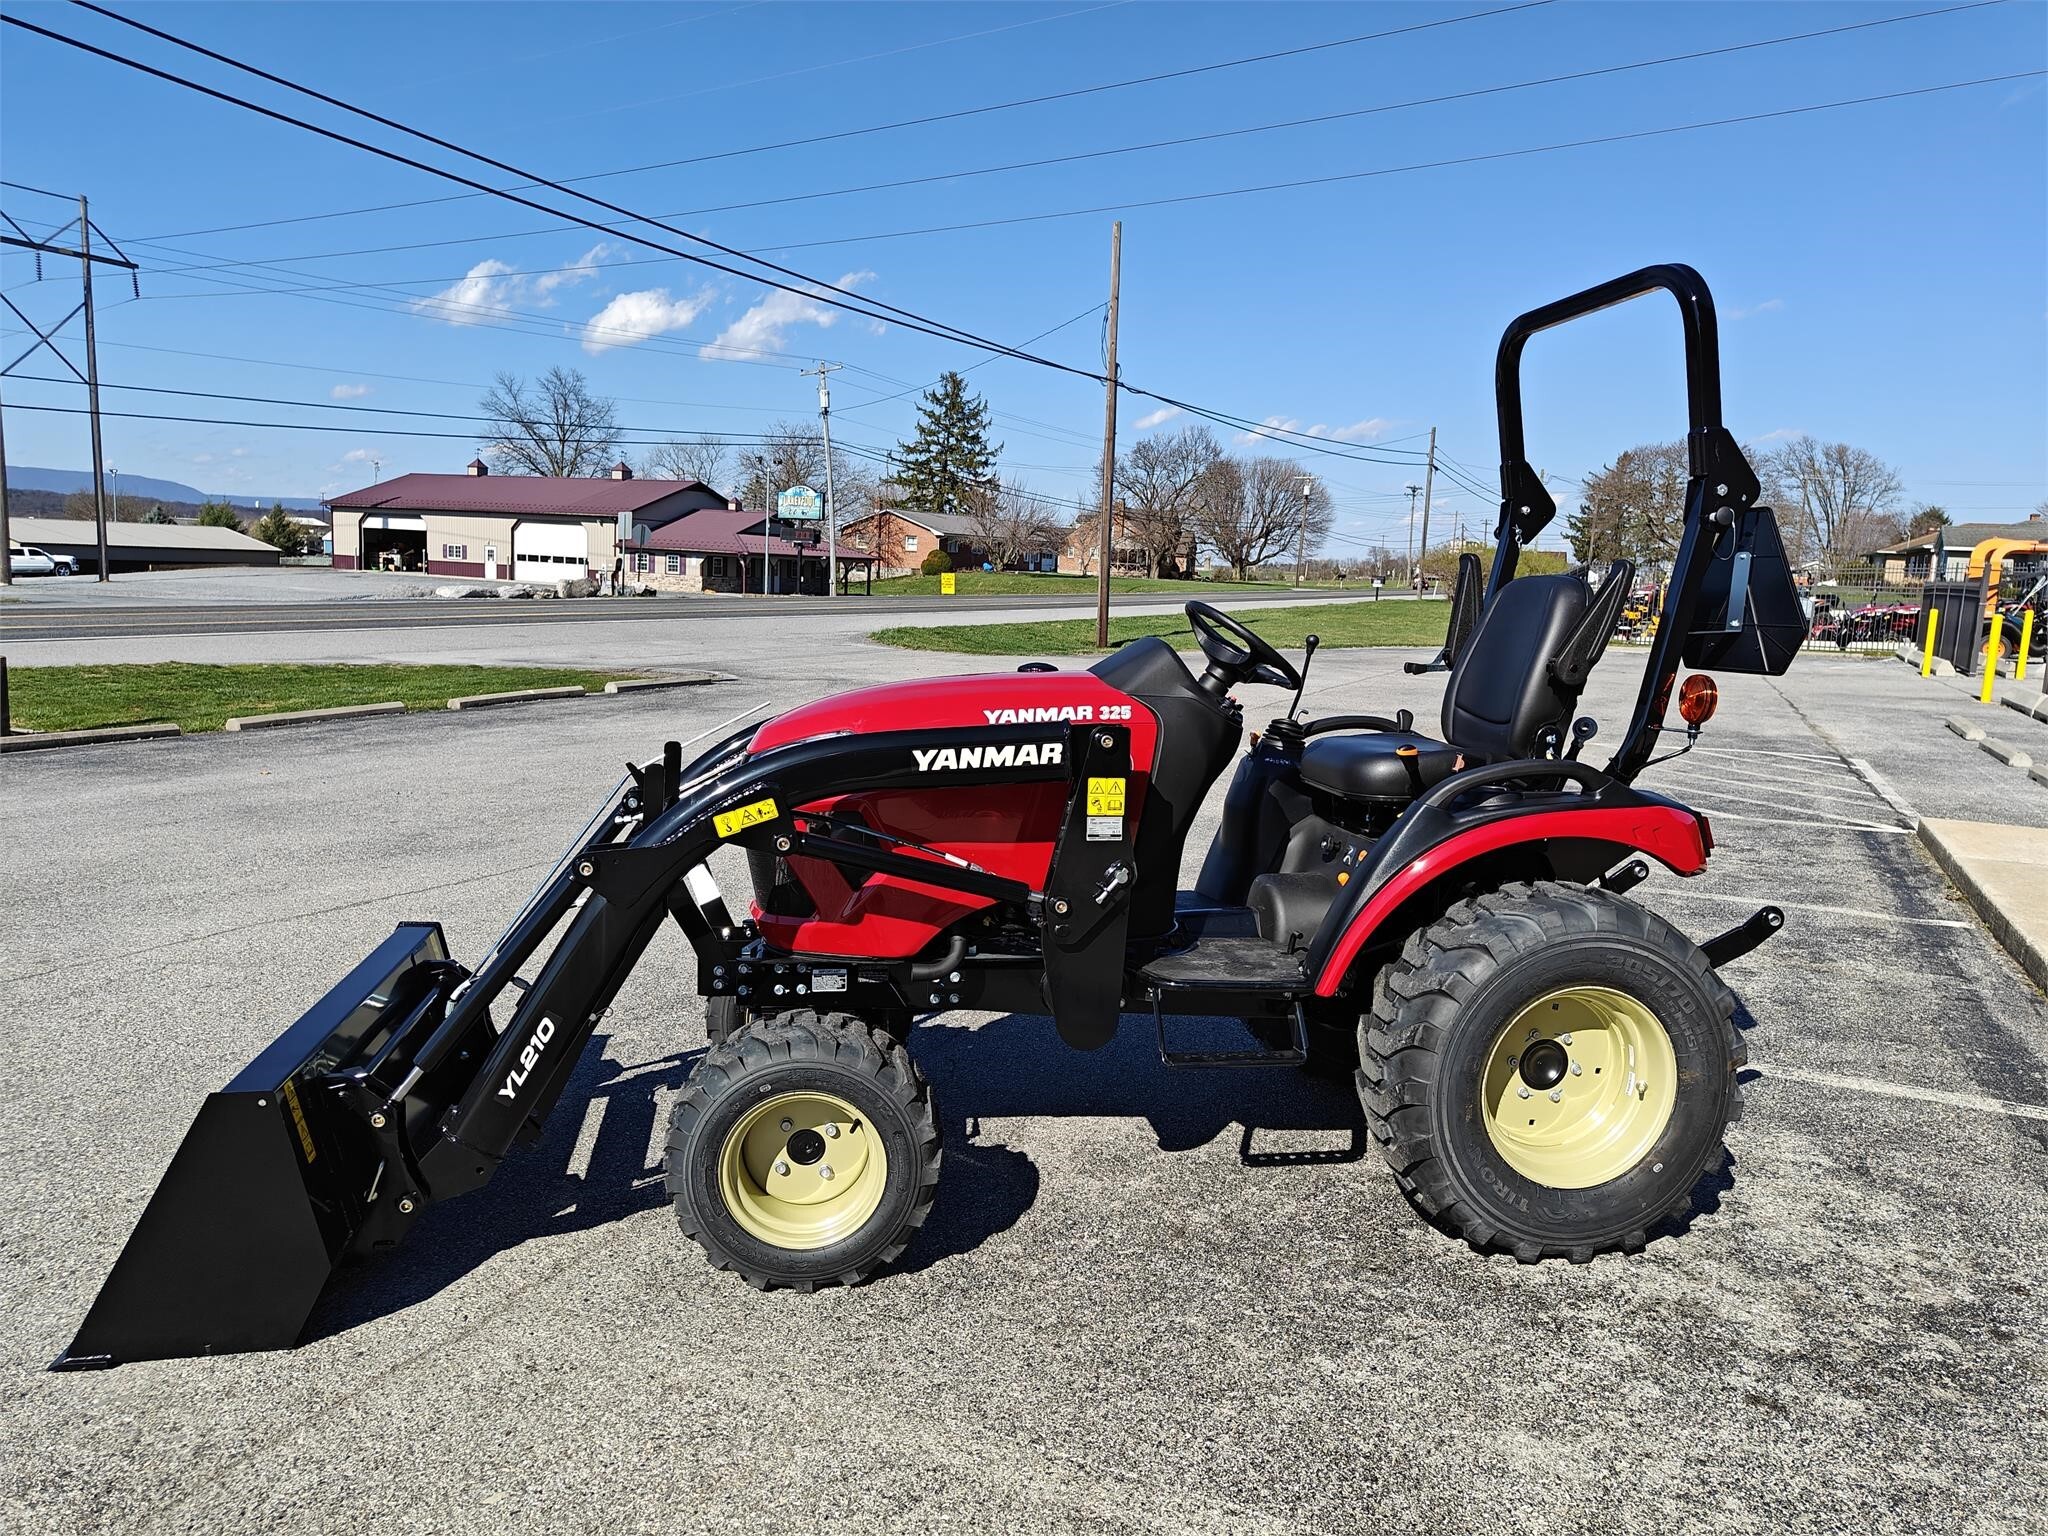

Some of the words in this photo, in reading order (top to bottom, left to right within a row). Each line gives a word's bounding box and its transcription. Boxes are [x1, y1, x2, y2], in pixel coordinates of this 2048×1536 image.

[982, 705, 1093, 725] YANMAR
[1098, 705, 1132, 720] 325
[911, 742, 1064, 772] YANMAR
[498, 1017, 555, 1099] YL210
